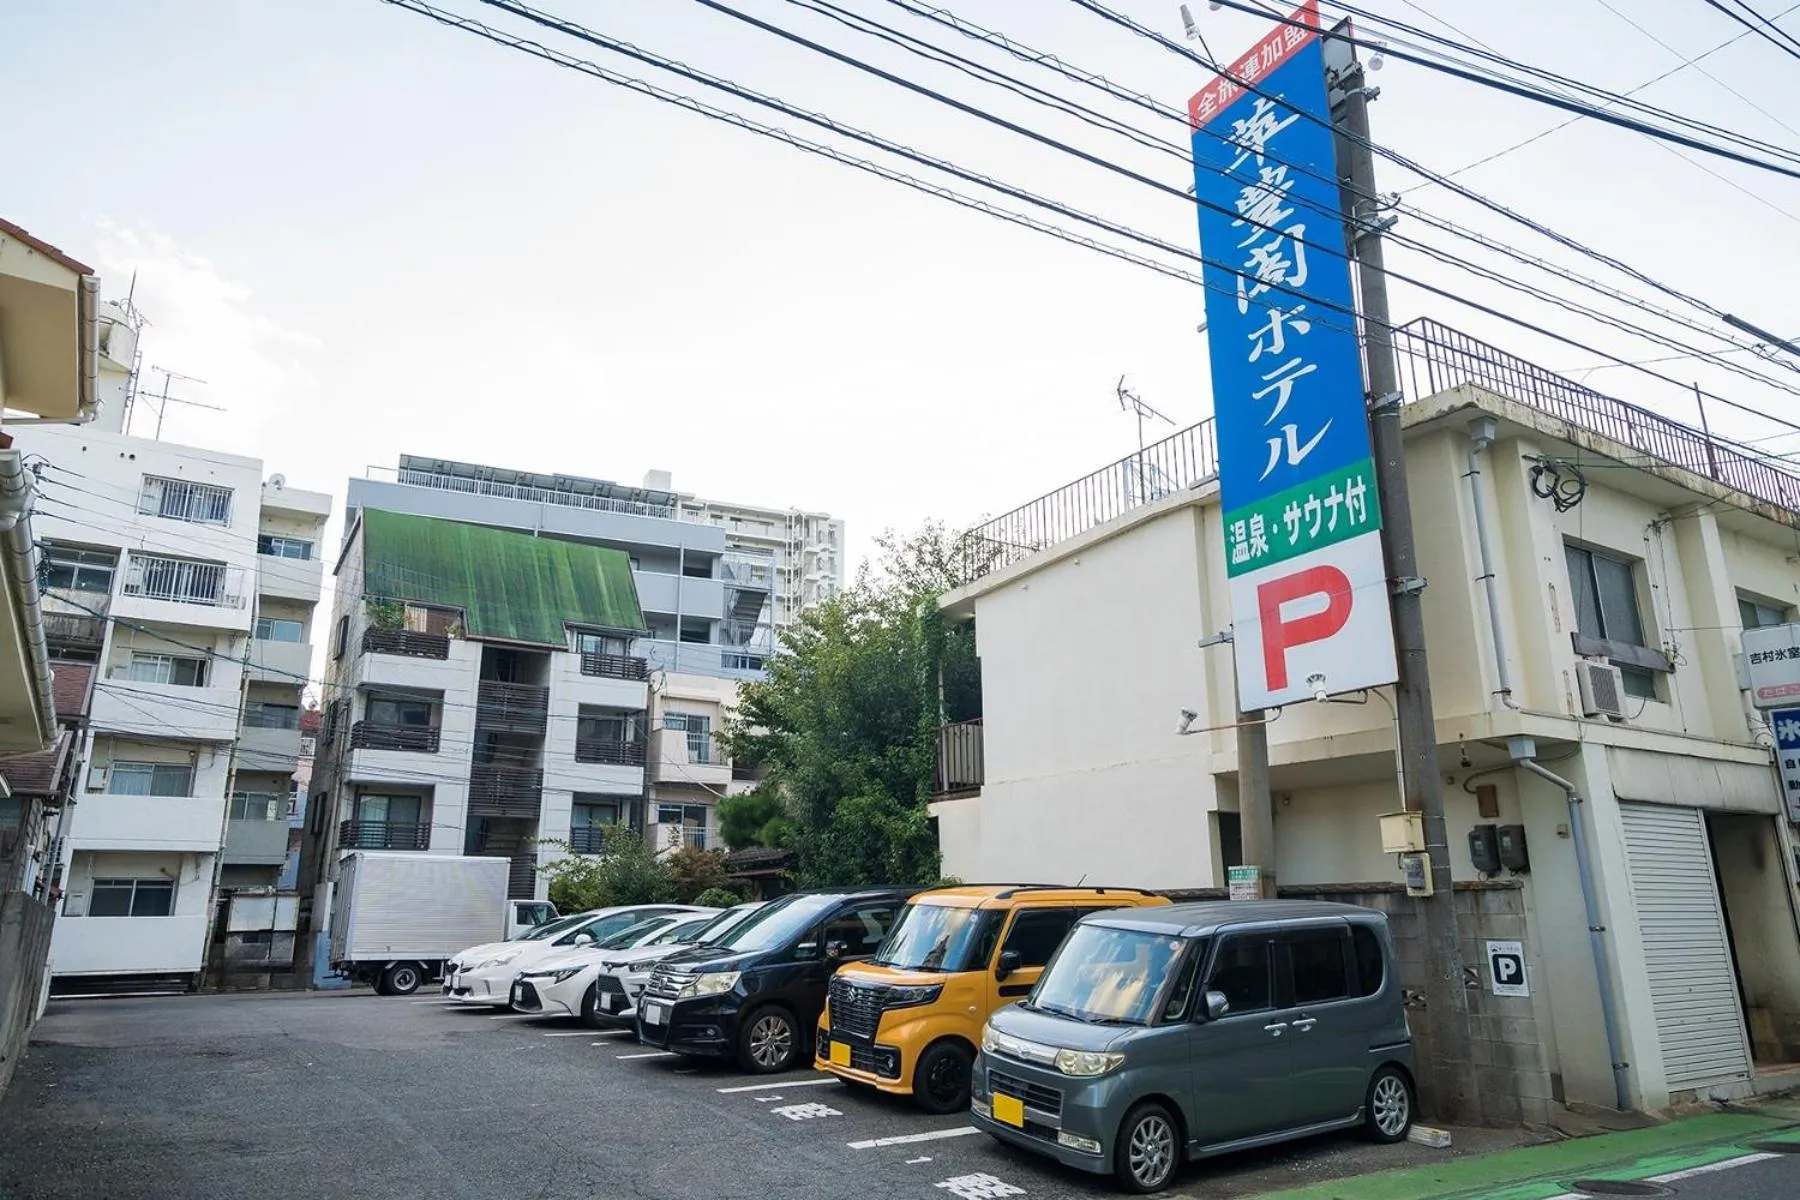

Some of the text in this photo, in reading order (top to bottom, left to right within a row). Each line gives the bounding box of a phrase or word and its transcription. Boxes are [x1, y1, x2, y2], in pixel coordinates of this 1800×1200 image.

[1230, 475, 1367, 565] 温泉・サウナ付
[1257, 564, 1353, 692] P
[1498, 957, 1516, 981] P
